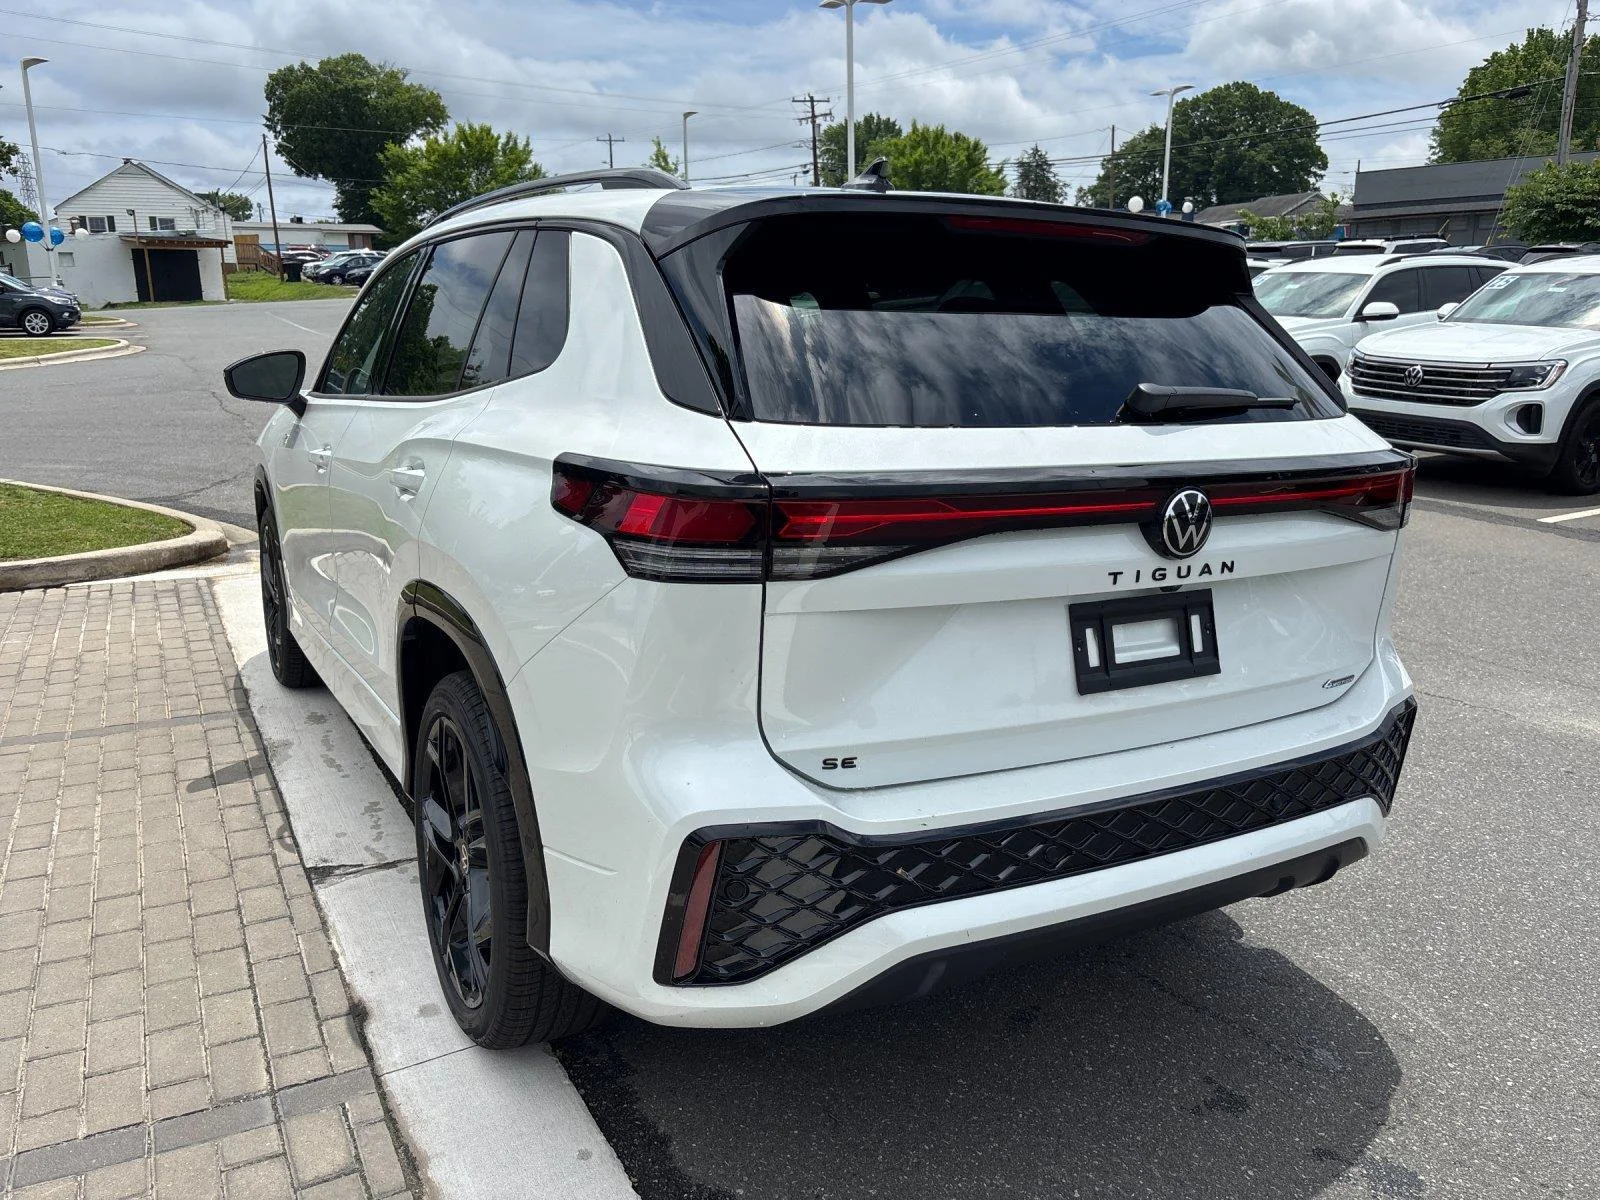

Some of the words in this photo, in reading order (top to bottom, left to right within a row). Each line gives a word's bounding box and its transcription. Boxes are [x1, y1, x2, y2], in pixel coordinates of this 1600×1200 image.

[1404, 366, 1422, 386] VW
[1163, 490, 1211, 556] VW
[1108, 560, 1234, 585] TIGUAN
[822, 757, 858, 770] SE
